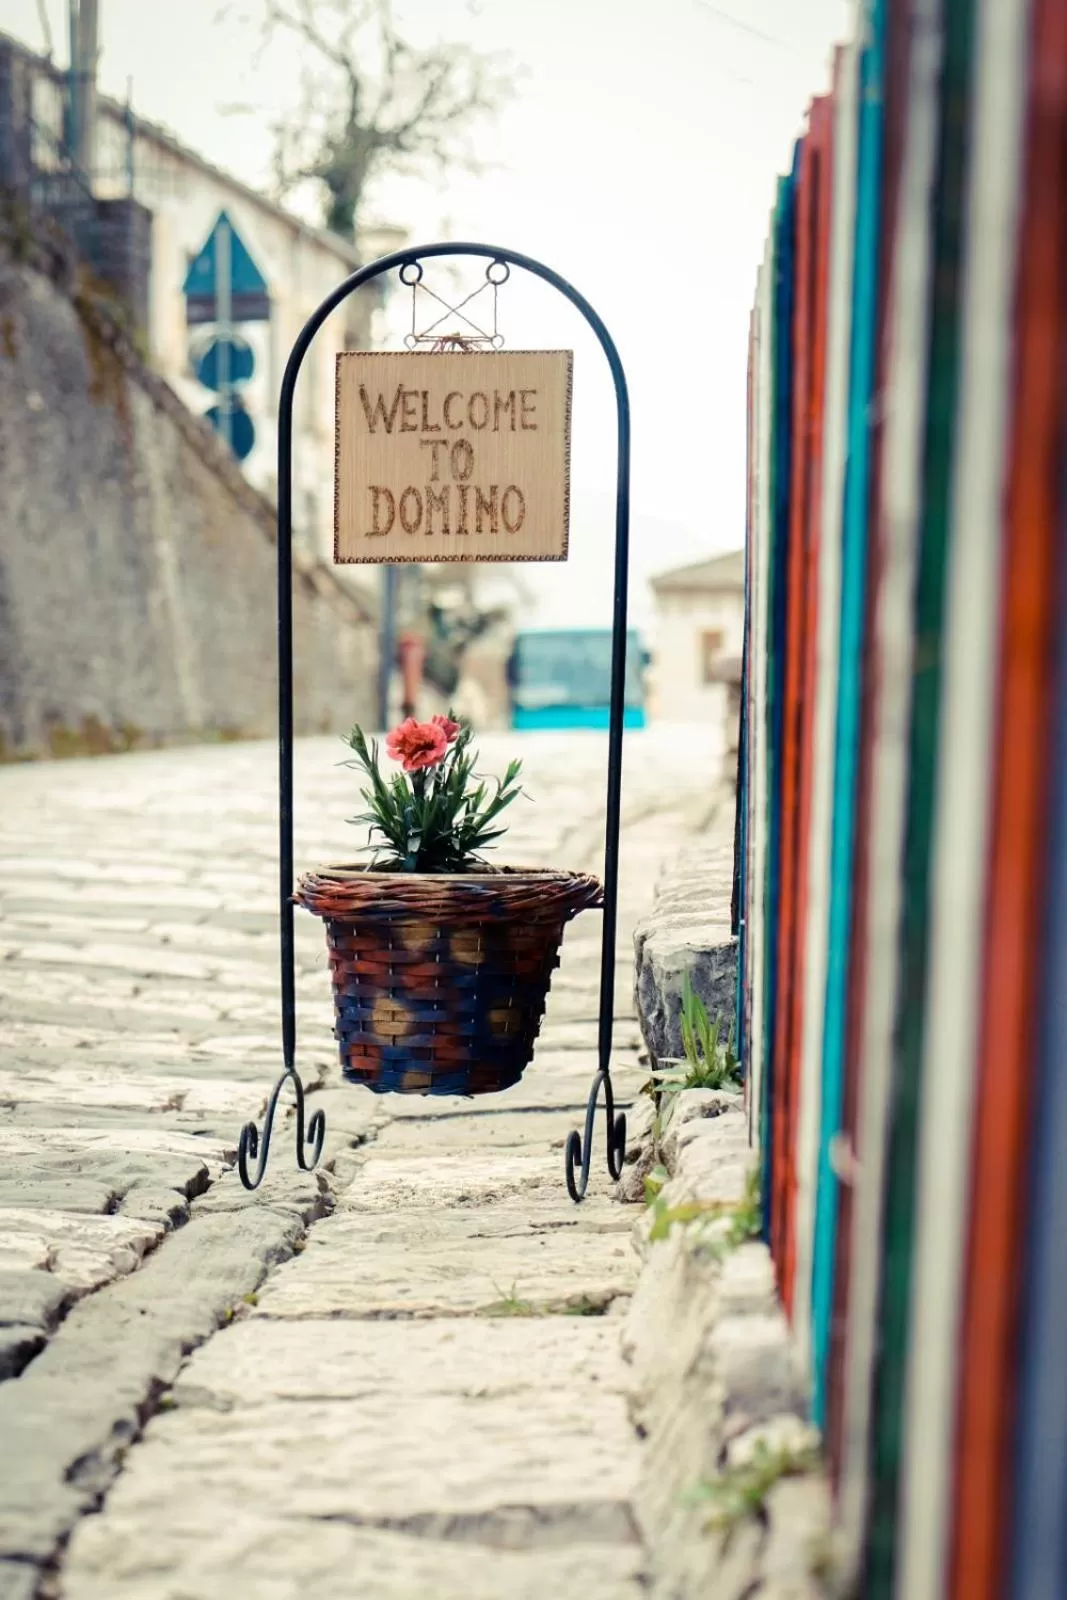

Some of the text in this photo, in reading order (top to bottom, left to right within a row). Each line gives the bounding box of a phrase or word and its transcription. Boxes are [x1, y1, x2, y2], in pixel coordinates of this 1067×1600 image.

[359, 384, 538, 434] WELCOME
[419, 438, 475, 482] TO
[364, 485, 526, 538] DOMINO
